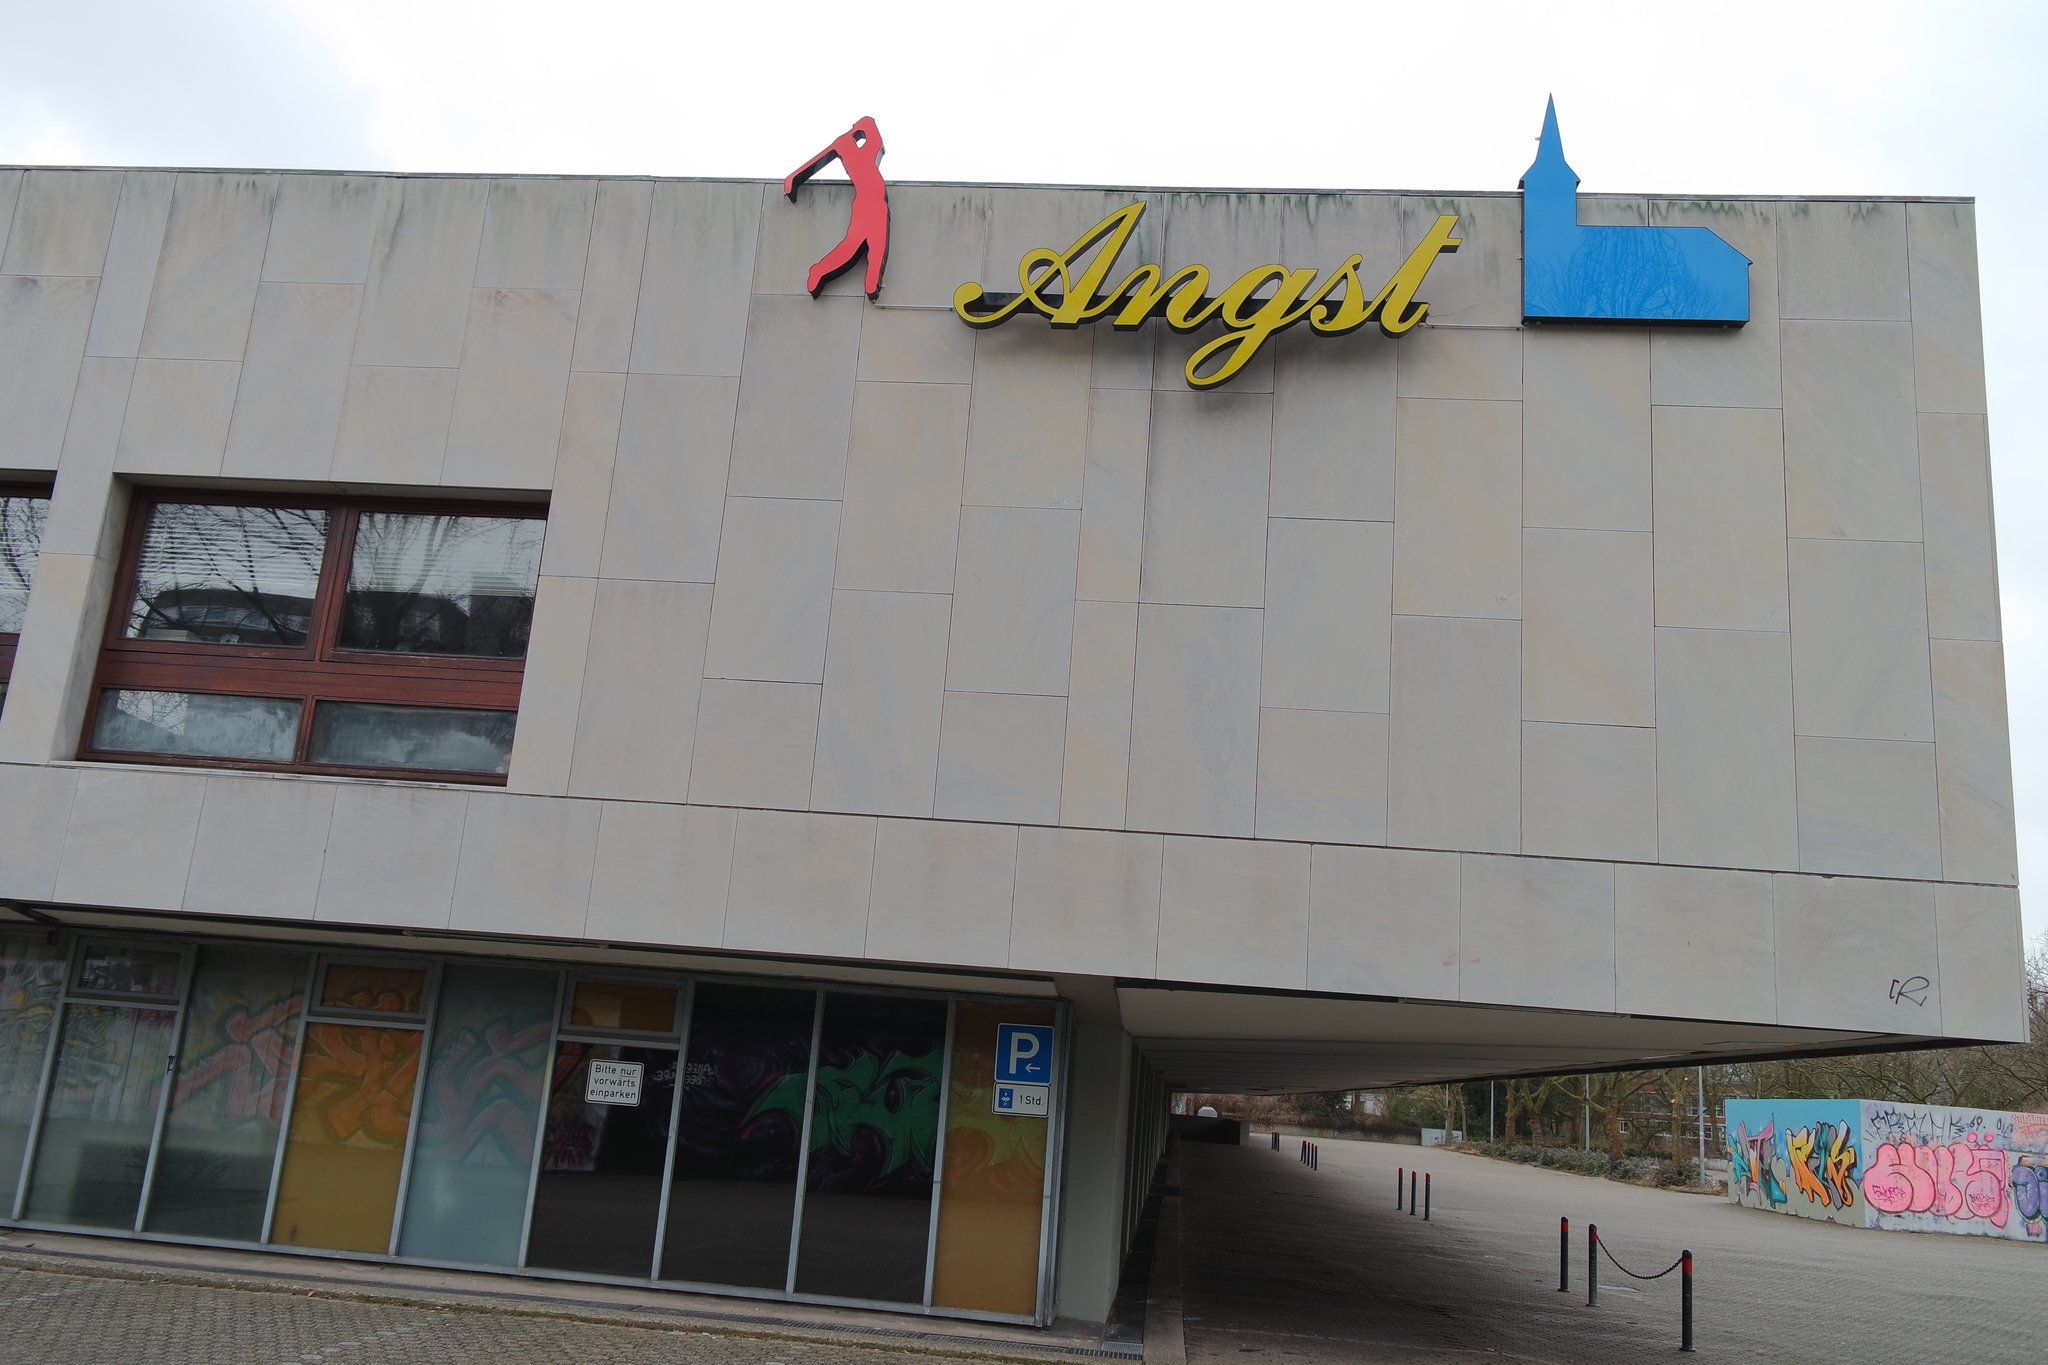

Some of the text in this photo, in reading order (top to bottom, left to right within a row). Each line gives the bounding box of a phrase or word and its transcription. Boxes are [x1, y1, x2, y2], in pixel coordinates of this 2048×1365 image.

[953, 200, 1463, 390] Angst
[1009, 1031, 1040, 1075] P
[595, 1063, 637, 1076] Bitte nur
[594, 1076, 636, 1088] vorwärts
[590, 1087, 637, 1100] einparken
[1019, 1094, 1044, 1106] 1 Std.
